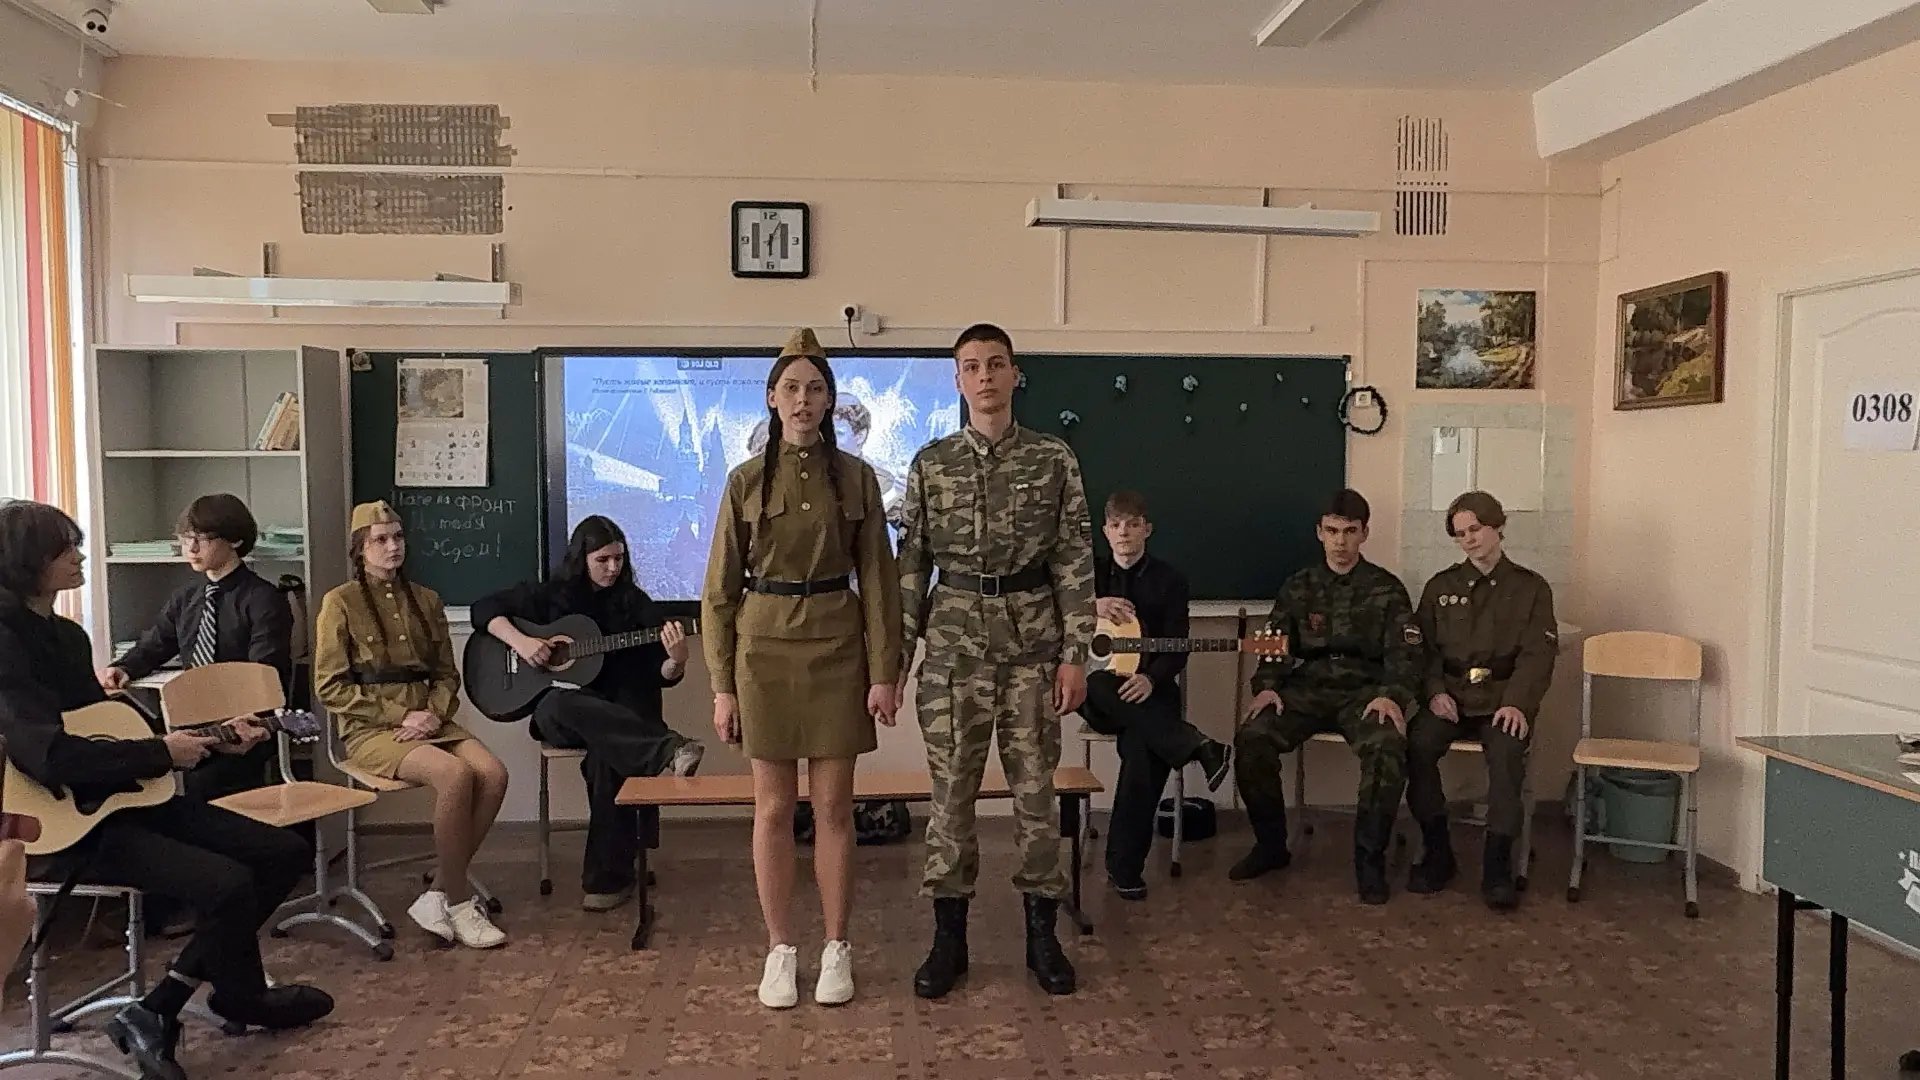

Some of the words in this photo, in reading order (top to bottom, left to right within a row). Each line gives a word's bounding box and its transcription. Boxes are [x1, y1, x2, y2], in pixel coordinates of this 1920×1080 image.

[763, 211, 778, 221] 12
[740, 235, 750, 245] 9
[791, 236, 800, 246] 3
[766, 260, 776, 271] 6
[1852, 393, 1913, 423] 0308
